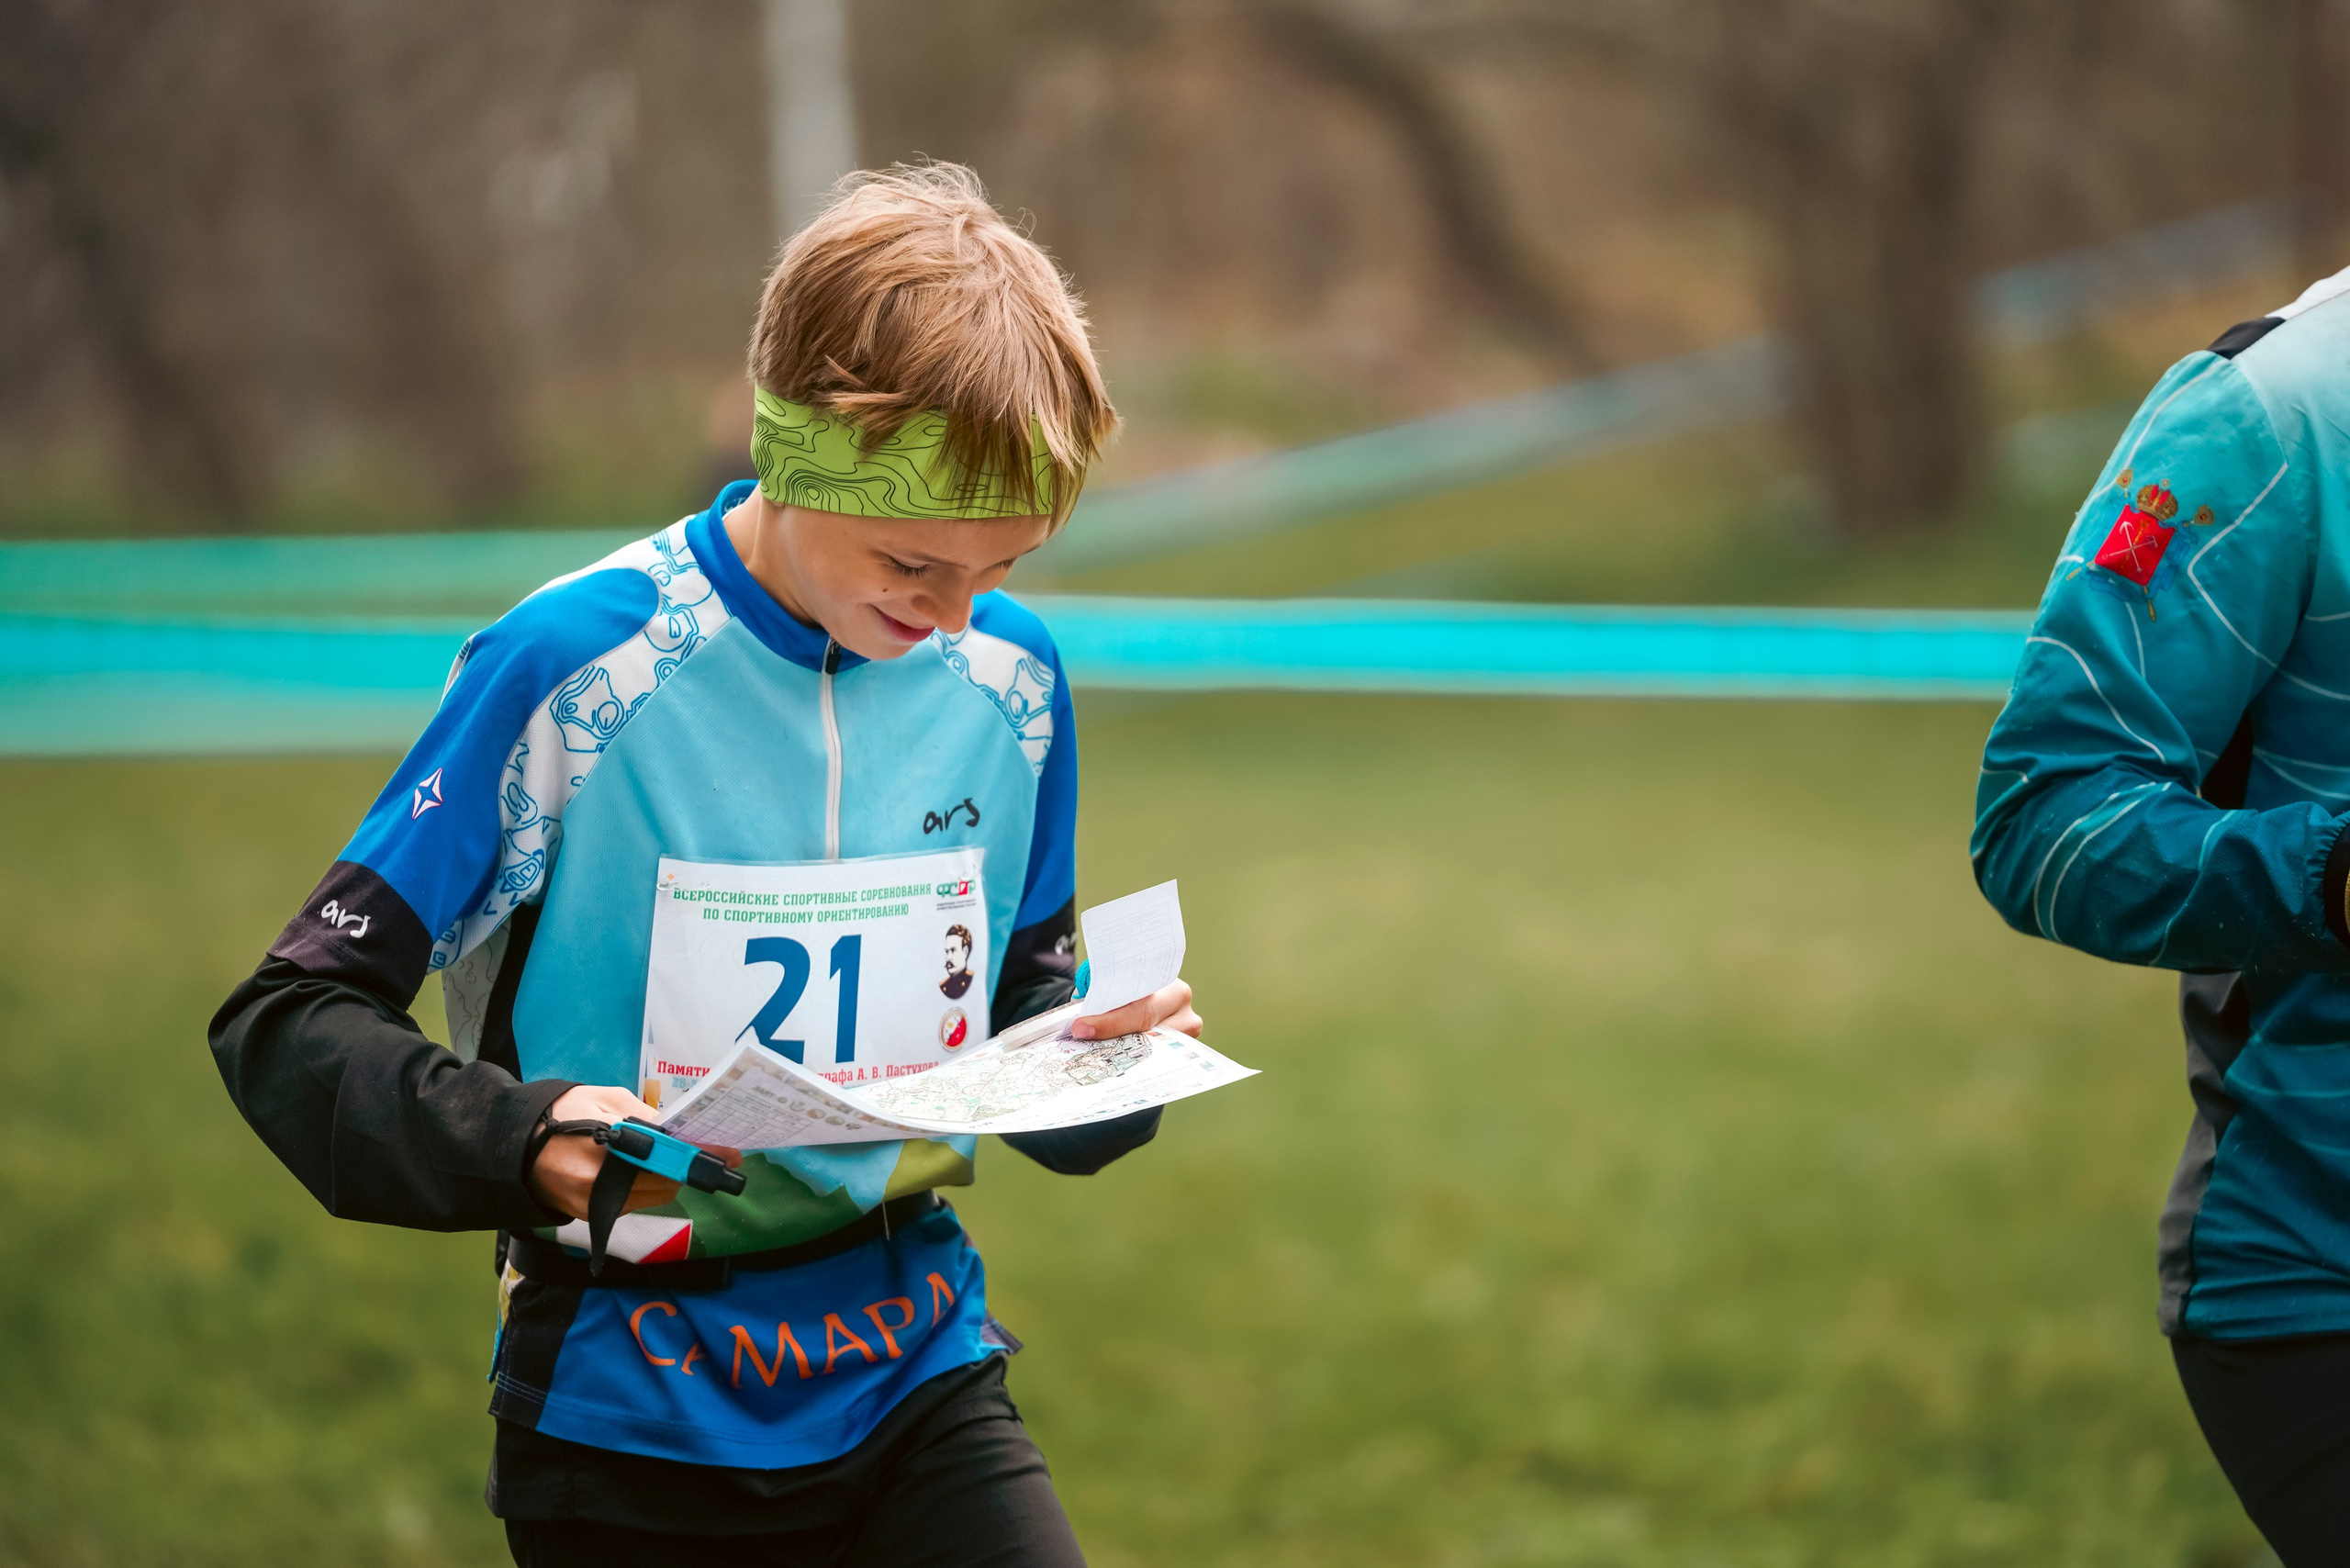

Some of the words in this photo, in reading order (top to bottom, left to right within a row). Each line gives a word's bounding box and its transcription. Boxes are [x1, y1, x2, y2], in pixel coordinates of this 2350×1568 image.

[923, 797, 980, 834] ars
[673, 887, 779, 906] ВСЕРОССИЙСКИЕ
[783, 890, 857, 907] СПОРТИВНЫЕ
[860, 883, 932, 902] СОРЕВНОВАНИЯ
[702, 907, 720, 920] ПО
[723, 909, 813, 924] СПОРТИВНОМУ
[817, 902, 910, 923] ОРИЕНТИРОВАНИЮ
[735, 934, 862, 1065] 21
[857, 1068, 867, 1081] А.
[872, 1066, 882, 1079] В.
